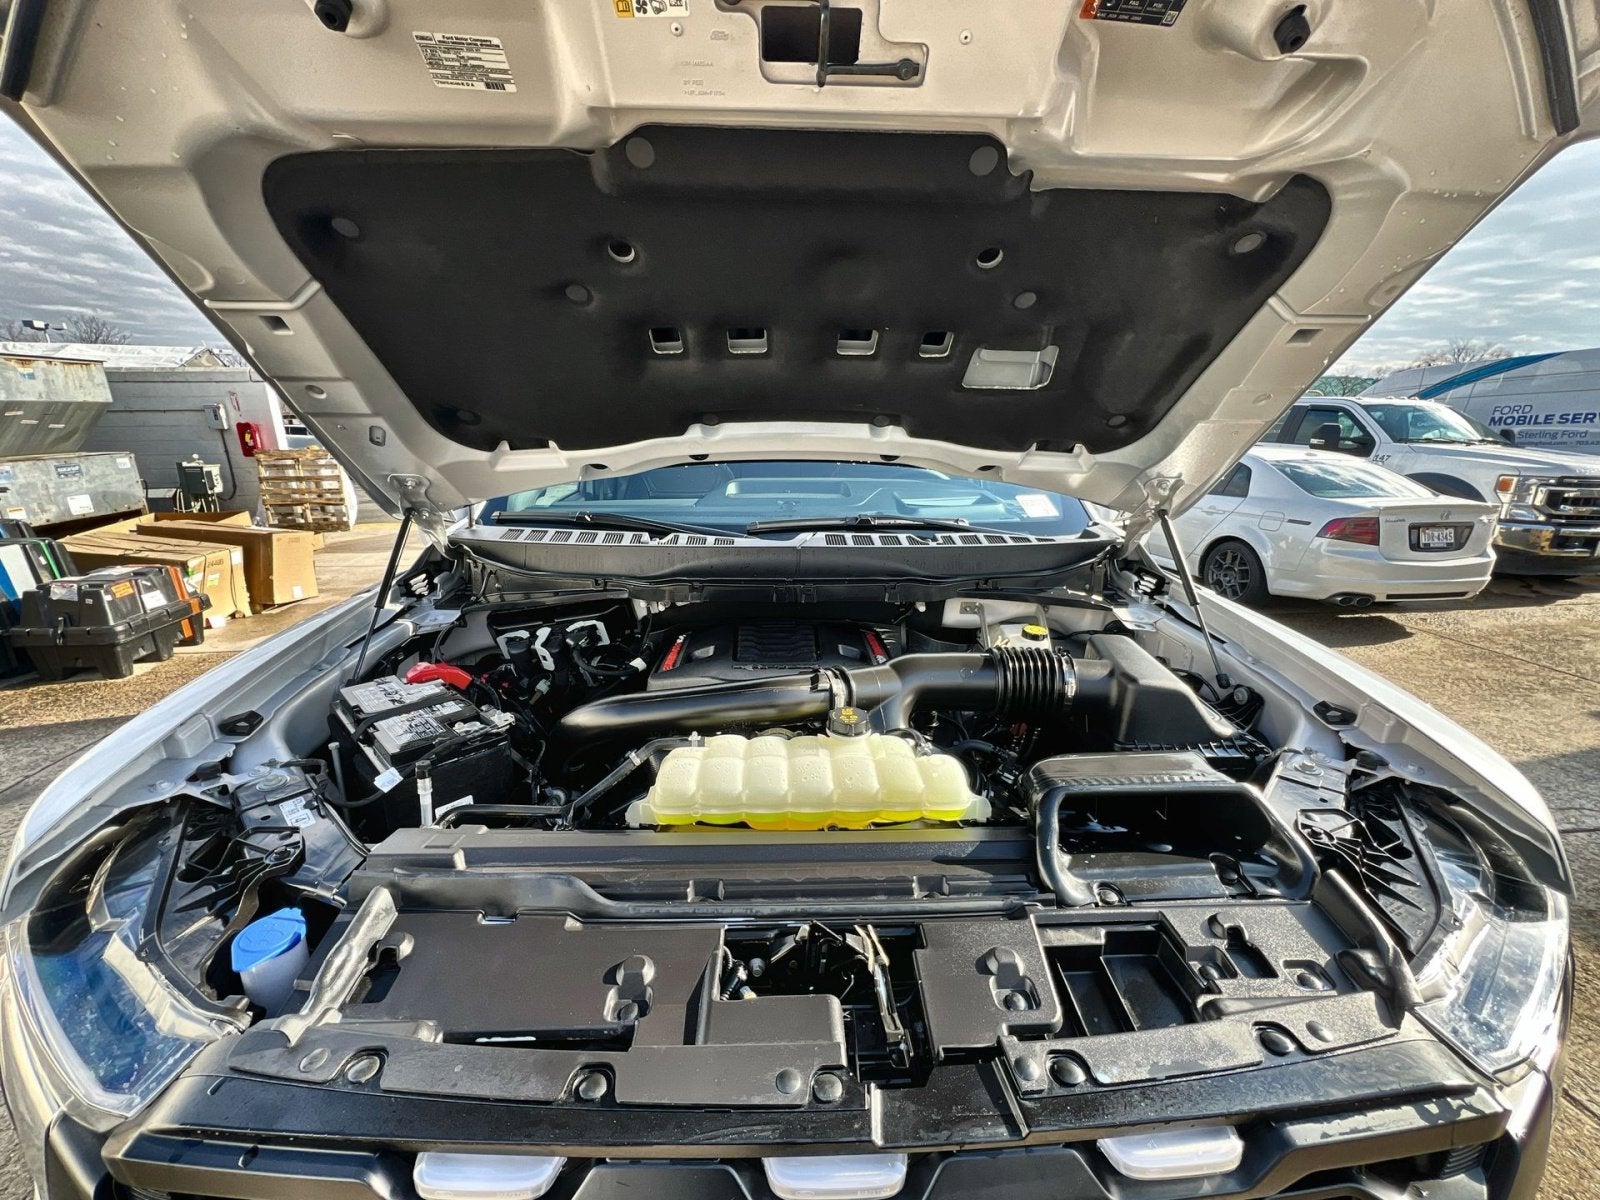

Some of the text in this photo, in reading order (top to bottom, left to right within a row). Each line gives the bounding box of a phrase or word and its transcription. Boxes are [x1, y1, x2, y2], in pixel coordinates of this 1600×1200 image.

[1492, 405, 1533, 415] FORD
[1488, 412, 1600, 427] MOBILE SER
[1518, 430, 1588, 440] Sterling Ford
